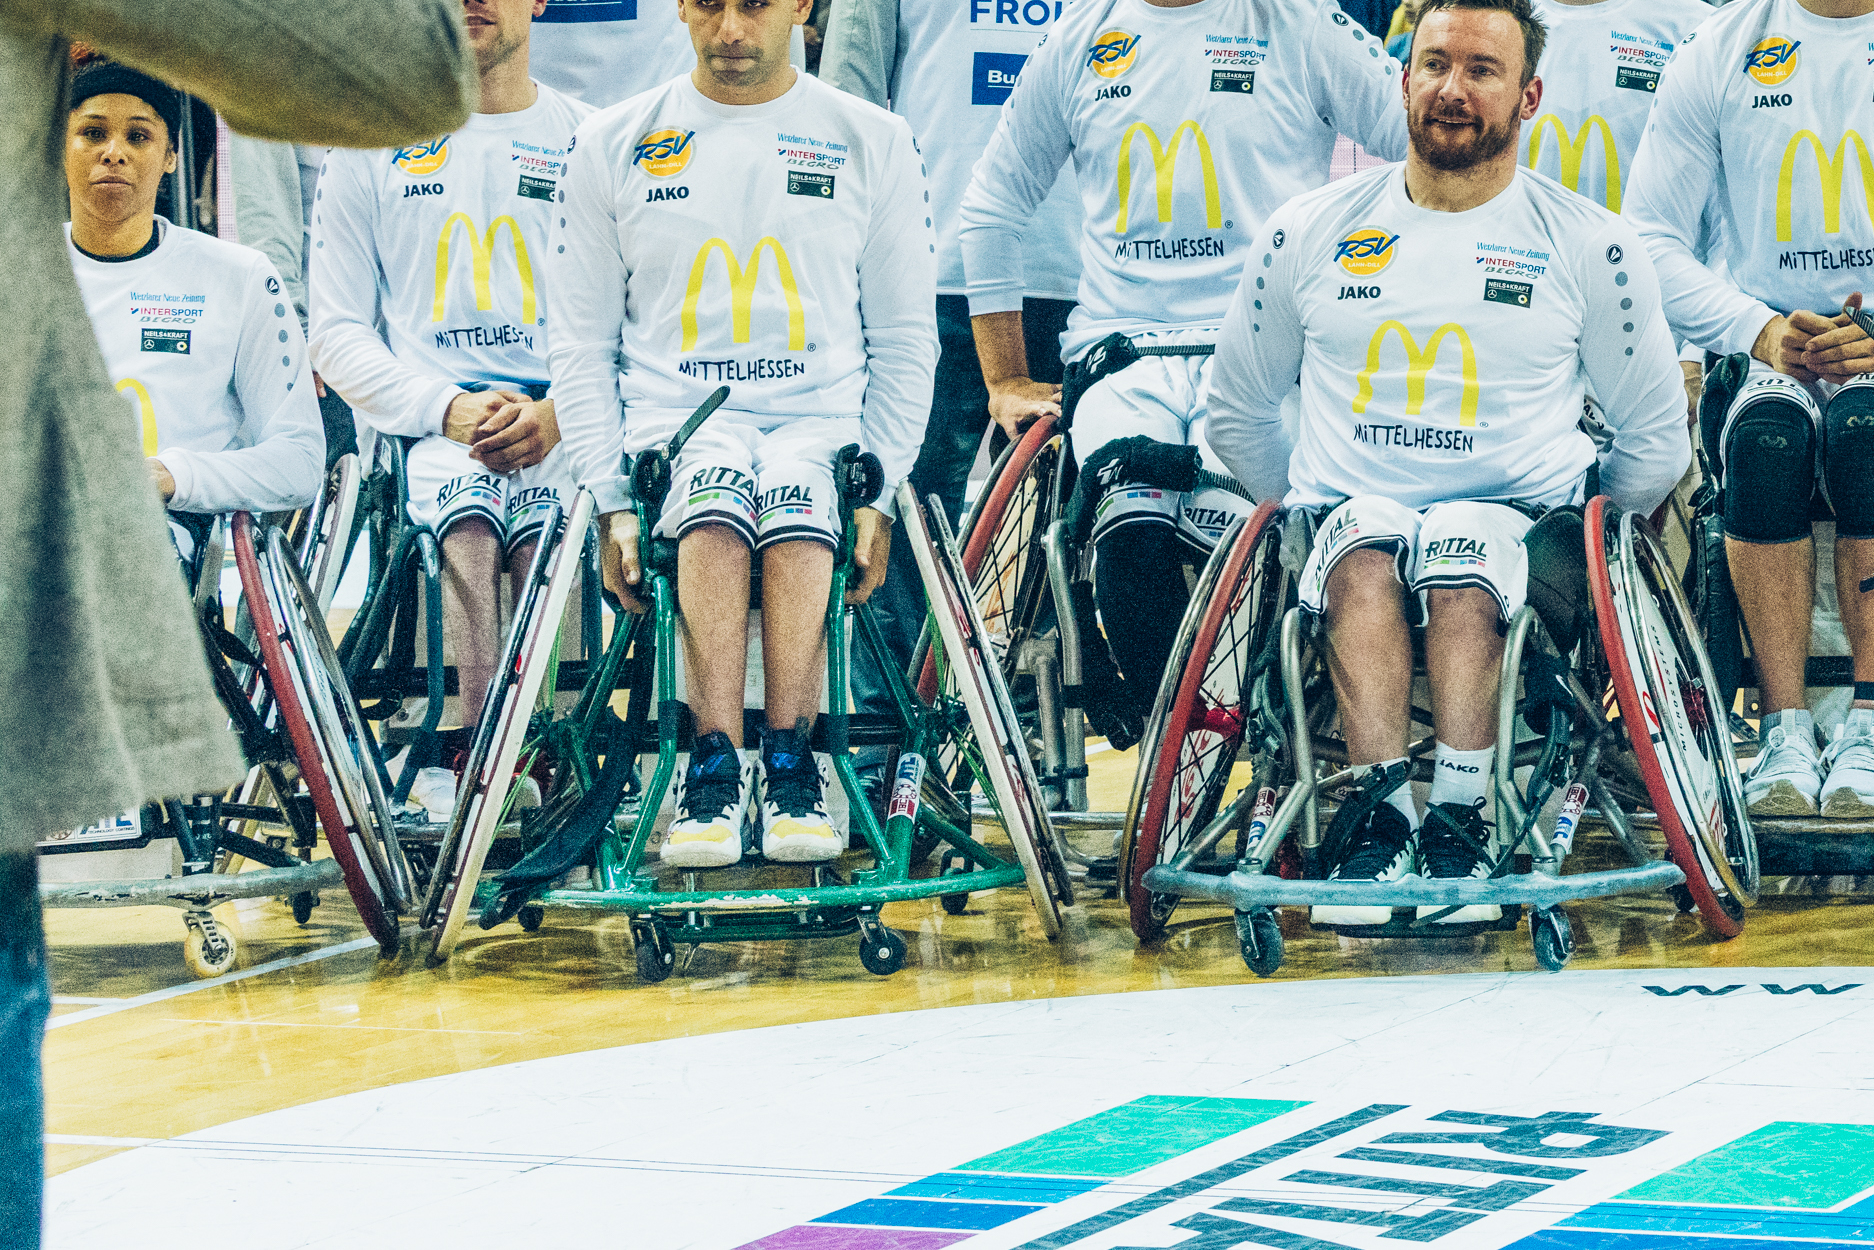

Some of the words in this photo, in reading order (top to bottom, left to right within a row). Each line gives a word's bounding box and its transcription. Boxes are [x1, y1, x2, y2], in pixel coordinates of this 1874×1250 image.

[1086, 34, 1142, 67] RSV
[1212, 49, 1267, 62] INTERSPORT
[1742, 40, 1802, 74] RSV
[1756, 70, 1788, 78] LAHN-DILL
[1095, 85, 1132, 102] JAKO
[1751, 93, 1793, 109] JAKO
[632, 130, 696, 166] RSV
[520, 155, 562, 169] INTERSP
[786, 149, 846, 166] INTERSPORT
[518, 163, 558, 176] BEGR
[403, 182, 445, 198] JAKO
[645, 185, 690, 203] JAKO
[1333, 234, 1401, 262] RSV
[1526, 248, 1550, 262] Zeitung
[1347, 261, 1382, 269] LAHN-DILL
[1483, 266, 1539, 280] BEGRO
[1485, 256, 1547, 276] INTERSPORT
[1337, 285, 1382, 301] JAKO
[1487, 280, 1530, 293] NEILS&KRAFT
[130, 291, 162, 303] Wetzlarer
[163, 292, 180, 303] Neue
[138, 316, 196, 324] BEGRO
[140, 307, 204, 317] INTERSPORT
[144, 330, 188, 339] NEILS&KRAFT
[689, 466, 756, 496] RITTA
[508, 487, 561, 515] RITTAL
[757, 485, 814, 513] RITTAL
[1424, 537, 1488, 558] RITTAL
[1439, 759, 1480, 775] JAKO
